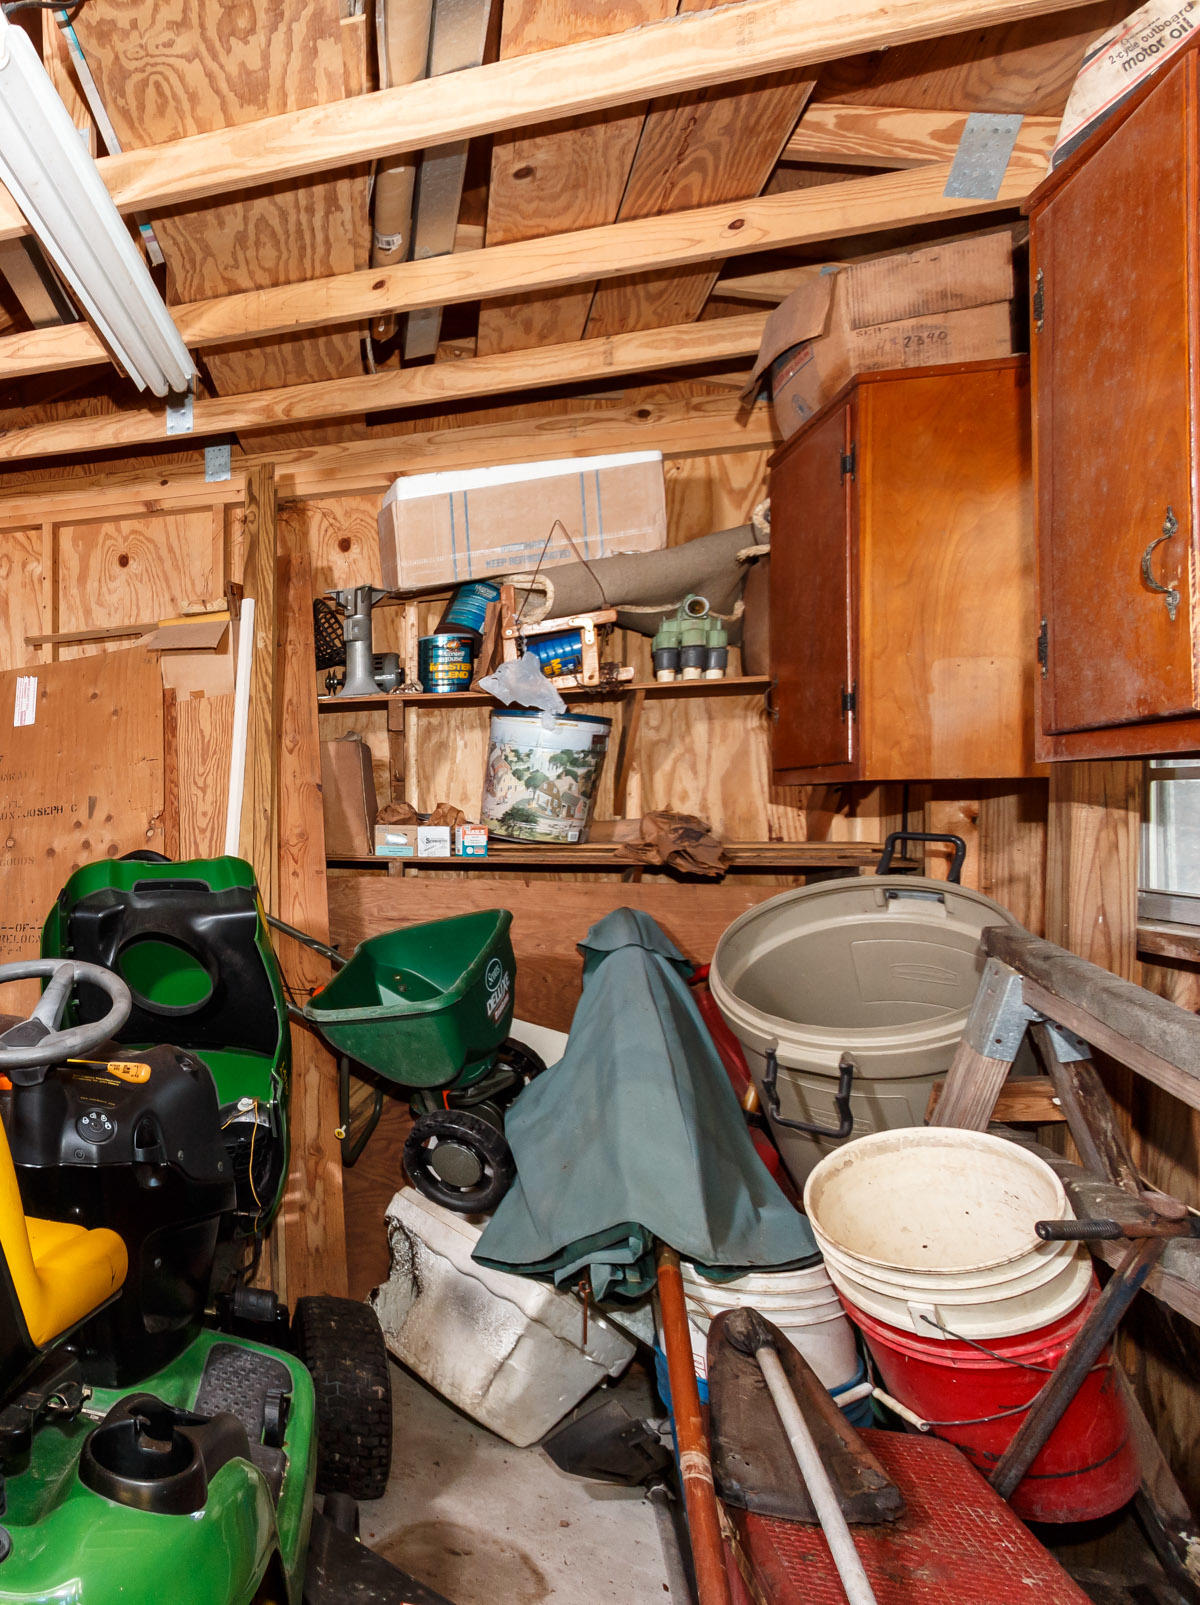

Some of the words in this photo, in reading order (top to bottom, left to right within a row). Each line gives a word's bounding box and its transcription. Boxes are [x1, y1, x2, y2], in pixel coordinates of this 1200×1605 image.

[1141, 1, 1195, 43] outboard
[1122, 37, 1167, 72] motor
[1169, 16, 1195, 40] oil
[429, 662, 472, 672] MASTER
[434, 671, 469, 680] BLEND
[0, 857, 35, 868] GOODS
